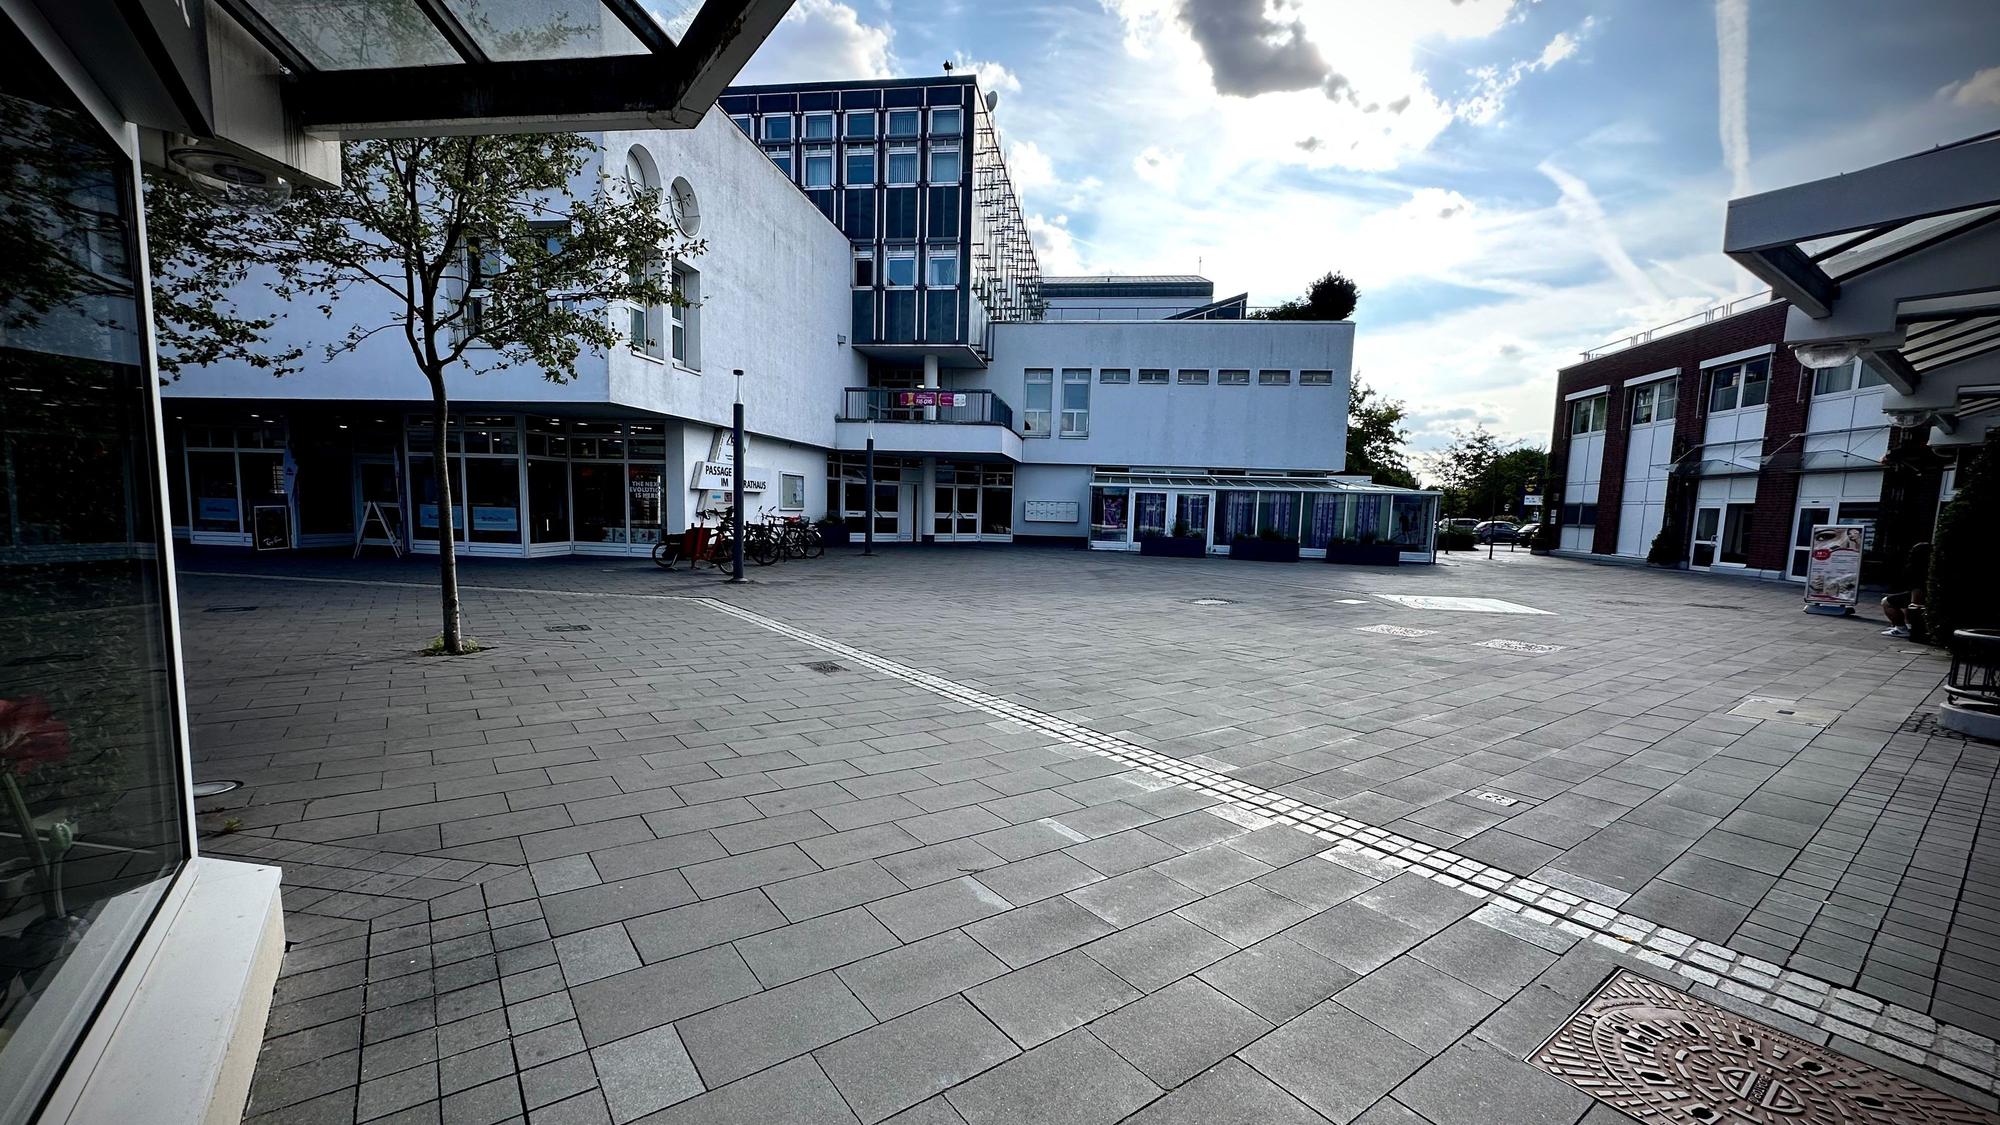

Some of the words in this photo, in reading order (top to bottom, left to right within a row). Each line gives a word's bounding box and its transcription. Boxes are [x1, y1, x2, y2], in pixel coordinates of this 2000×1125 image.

[705, 465, 732, 477] PASSAGE
[720, 478, 729, 487] IM
[743, 479, 766, 490] RATHAUS
